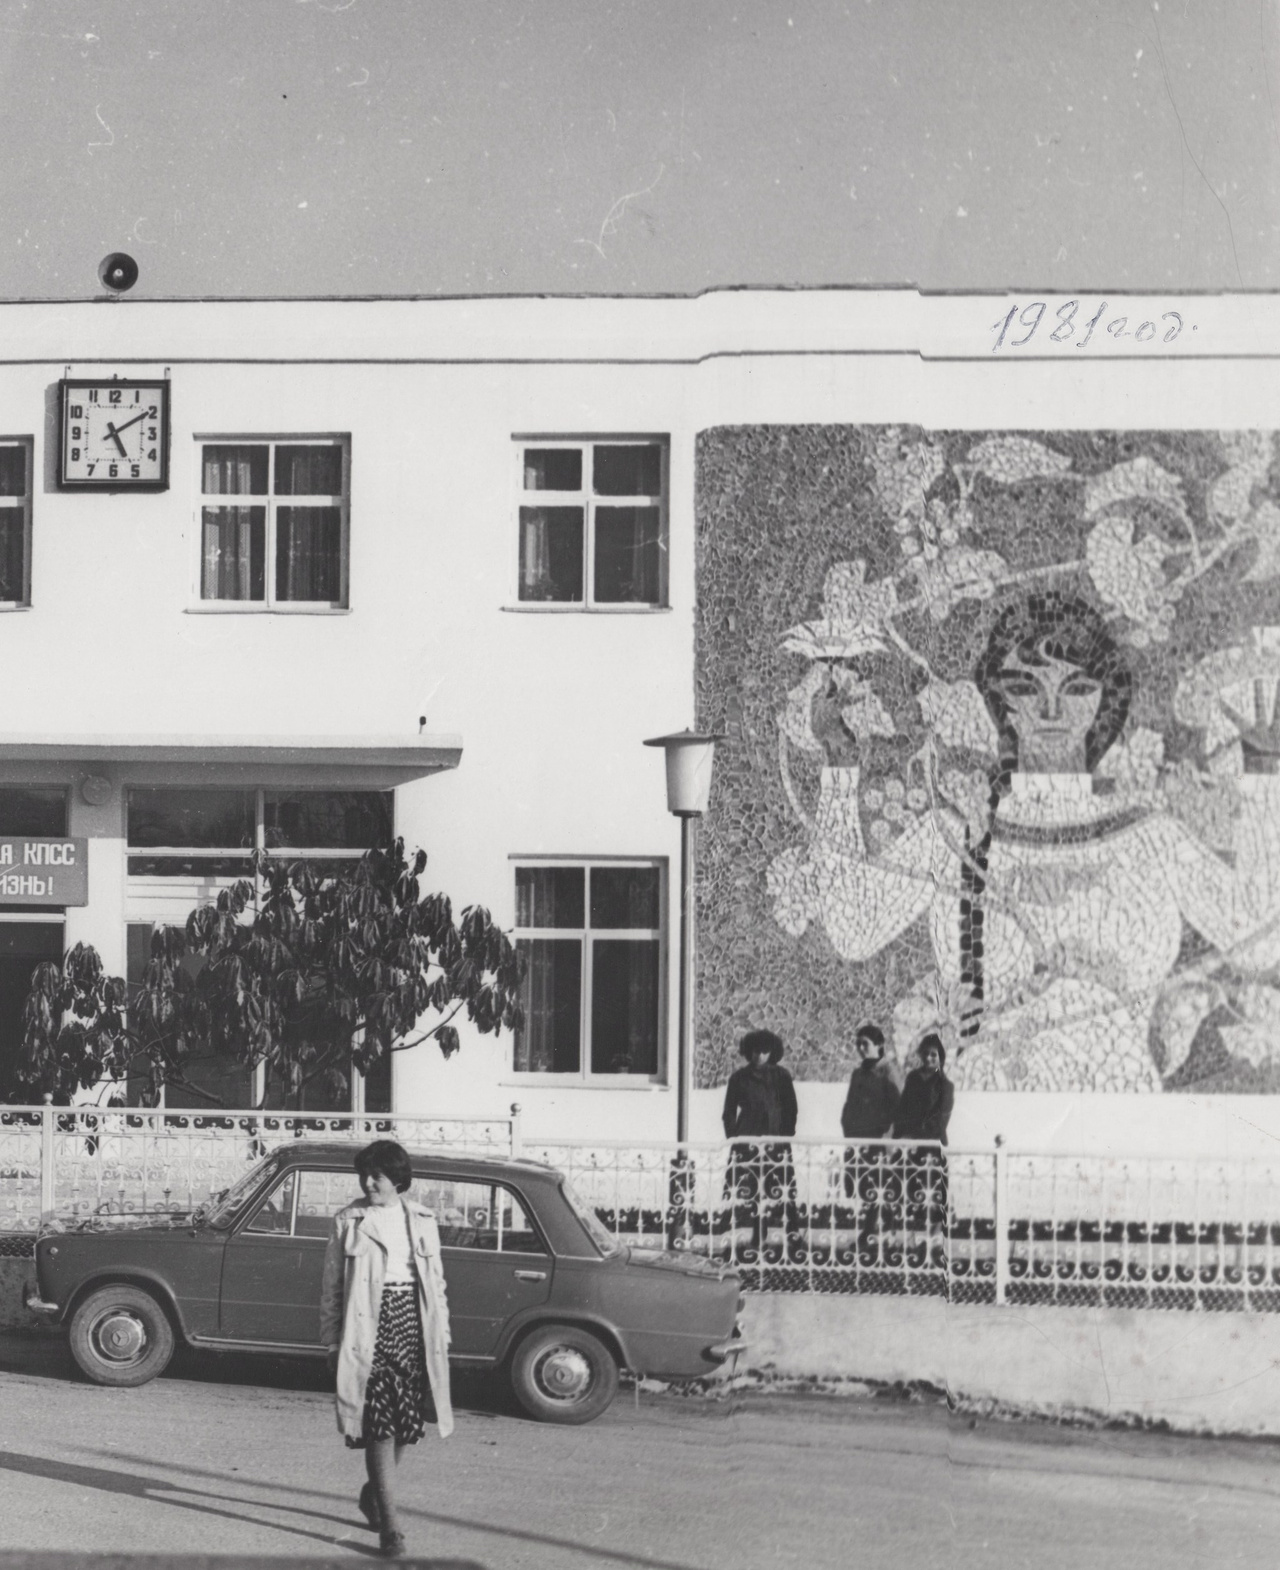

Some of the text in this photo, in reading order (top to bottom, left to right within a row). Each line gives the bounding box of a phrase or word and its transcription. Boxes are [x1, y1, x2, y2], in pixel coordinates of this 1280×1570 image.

[89, 389, 98, 403] 11
[109, 390, 122, 403] 12
[135, 390, 140, 403] 1
[70, 405, 83, 419] 10
[148, 406, 157, 419] 2
[72, 426, 81, 440] 9
[148, 427, 157, 441] 3
[71, 448, 80, 461] 8
[147, 448, 157, 462] 4
[87, 464, 95, 476] 7
[109, 464, 118, 477] 6
[131, 464, 140, 478] 5
[23, 842, 76, 865] КПСС
